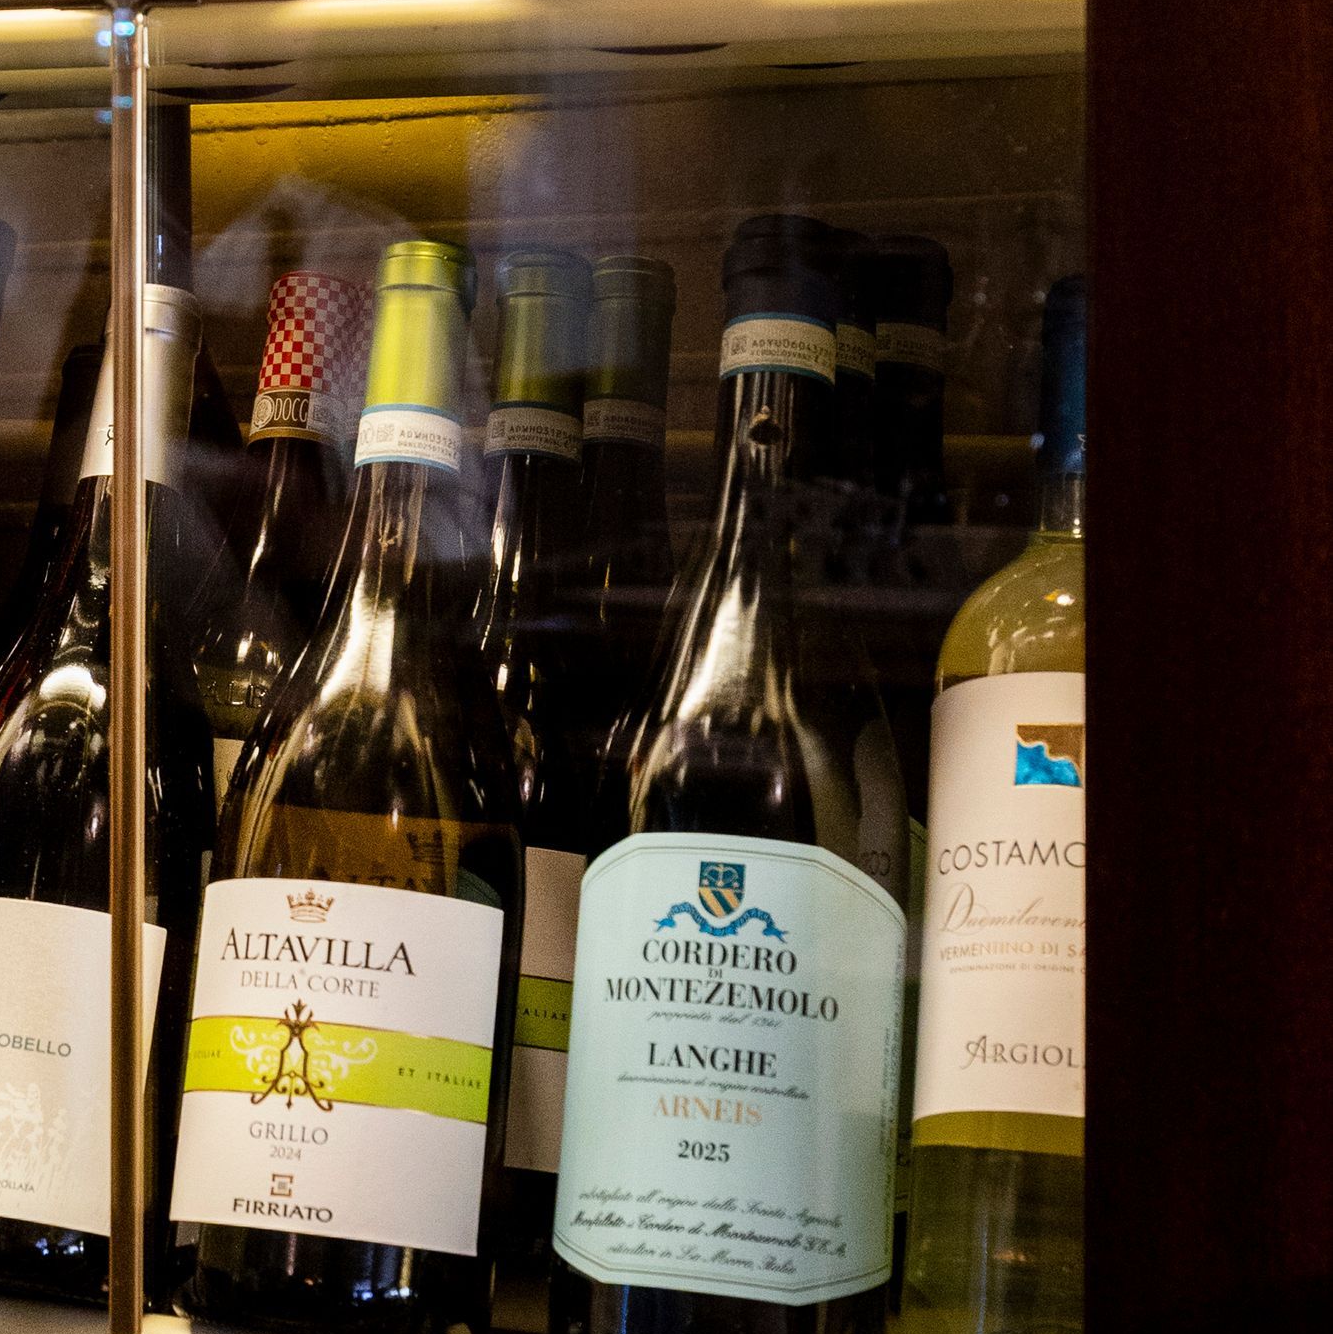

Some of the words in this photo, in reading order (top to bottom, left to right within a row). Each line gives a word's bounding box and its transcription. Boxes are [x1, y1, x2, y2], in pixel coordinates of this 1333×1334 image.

[274, 397, 309, 423] DOCG
[221, 926, 417, 977] ALTAVILLA
[642, 938, 798, 976] CORDERO
[940, 940, 1035, 961] VERMENTINO
[1041, 941, 1060, 956] DI
[240, 970, 298, 990] DELLA
[307, 974, 380, 999] CORTE
[708, 967, 724, 979] DI
[603, 975, 841, 1023] MONTEZEMOLO
[647, 1041, 778, 1079] LANGHE
[398, 1066, 414, 1078] ET
[427, 1070, 483, 1091] ITALIAE
[652, 1093, 764, 1127] ARNEIS
[249, 1121, 330, 1145] GRILLO
[269, 1146, 303, 1162] 2024
[676, 1138, 732, 1165] 2025
[232, 1197, 334, 1224] FIRRIATO
